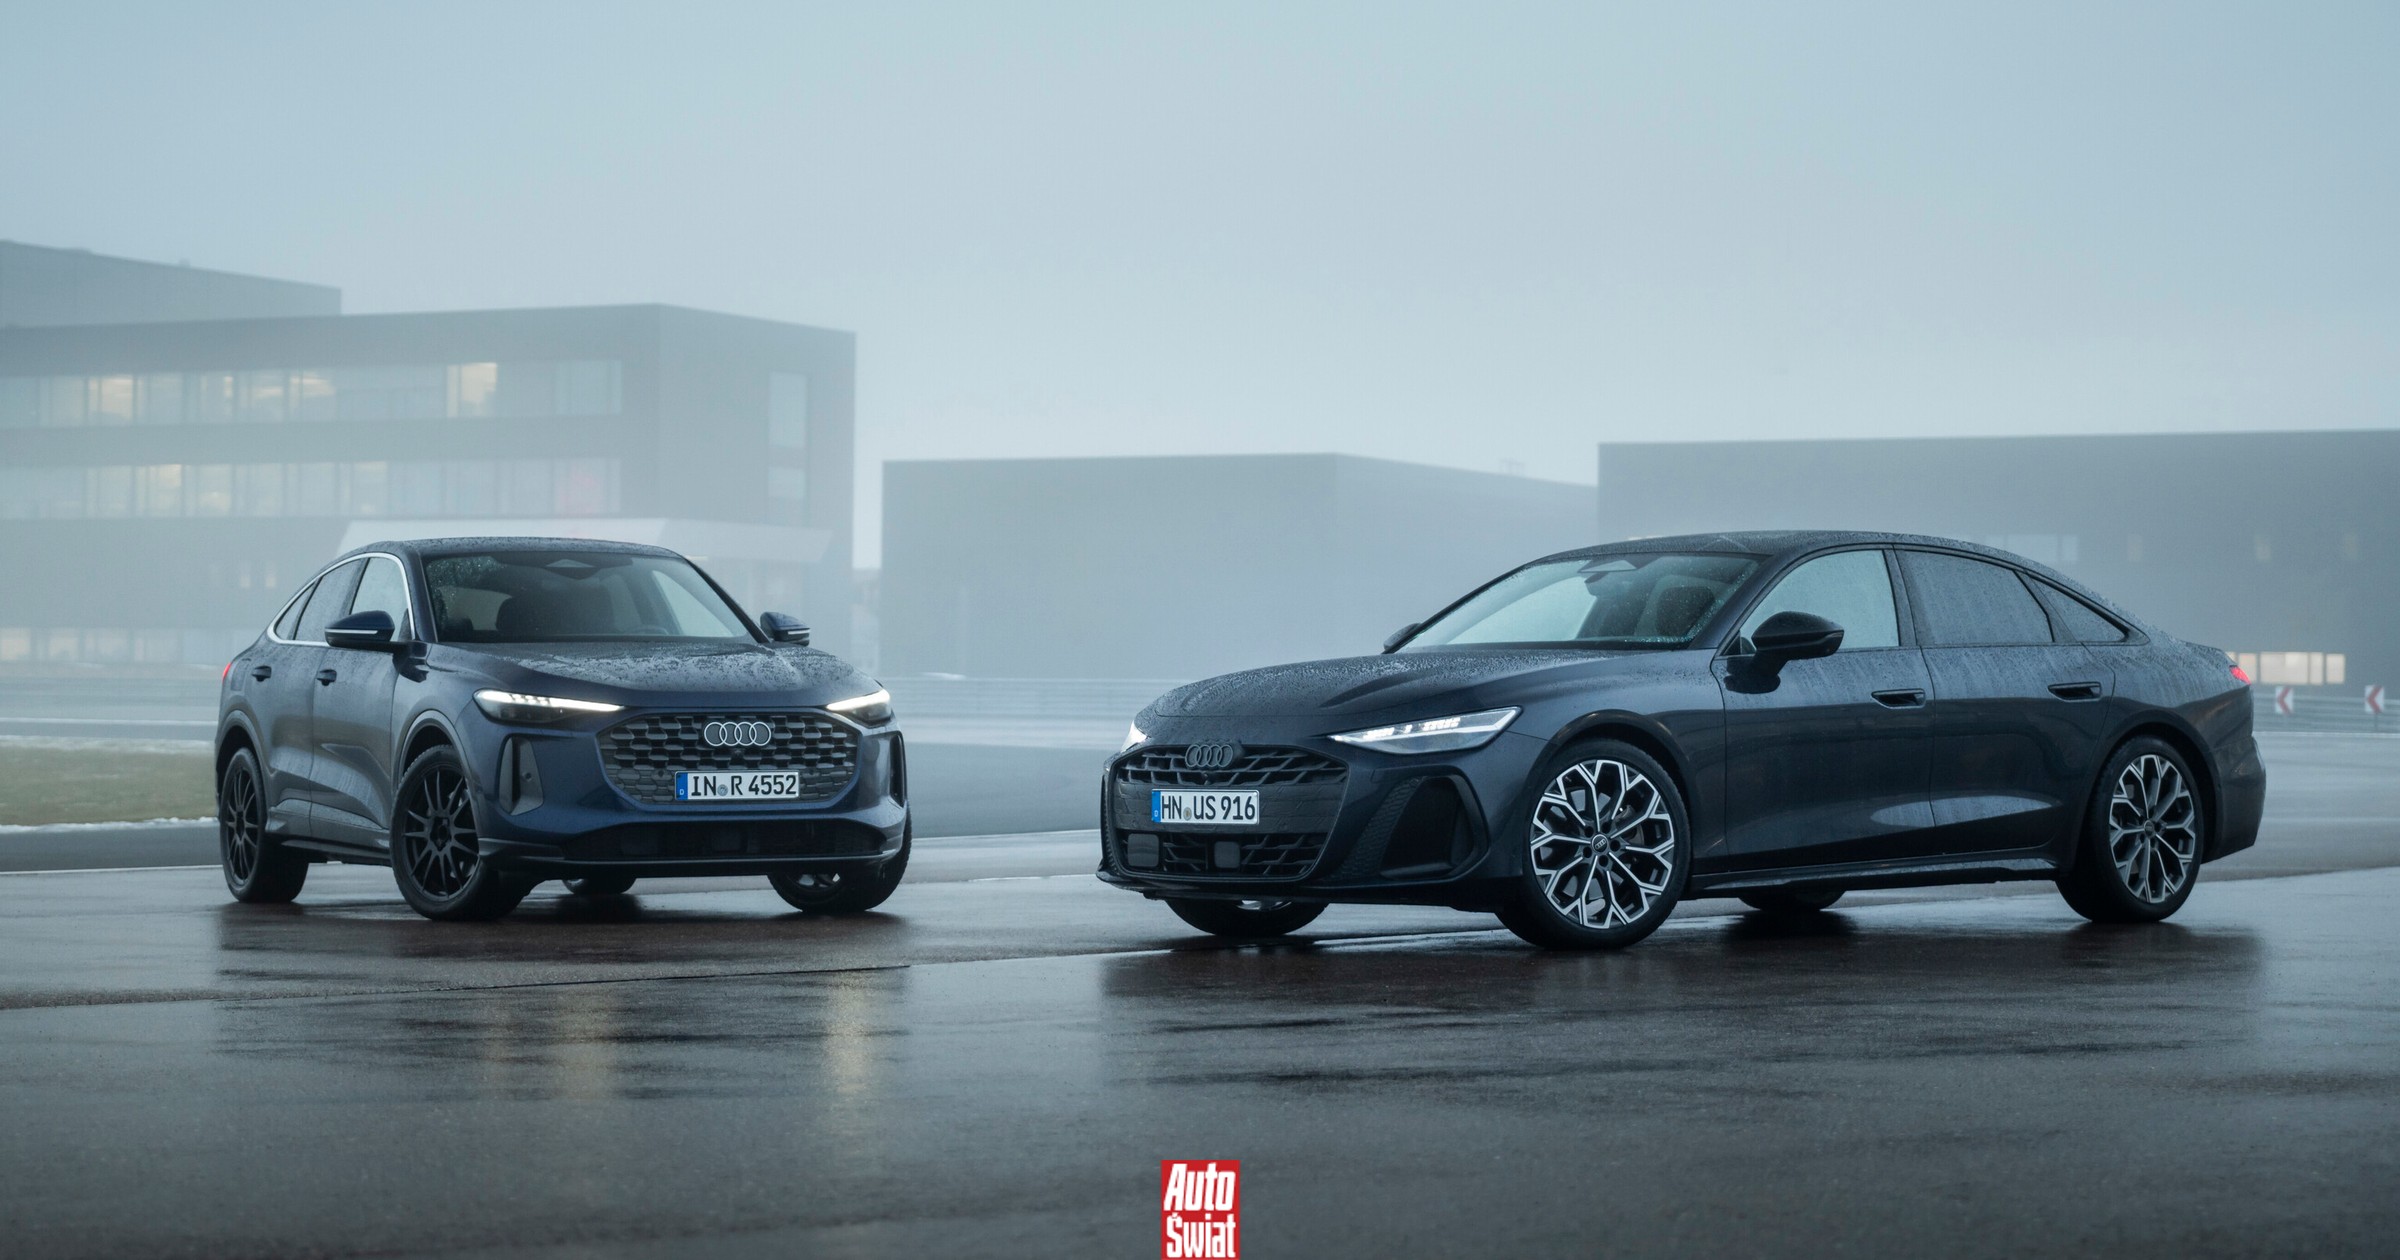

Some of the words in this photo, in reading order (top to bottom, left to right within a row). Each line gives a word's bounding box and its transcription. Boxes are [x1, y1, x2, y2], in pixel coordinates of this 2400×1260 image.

[691, 776, 717, 796] IN
[731, 776, 743, 796] R
[748, 775, 797, 796] 4552
[1162, 796, 1182, 819] HN
[1194, 796, 1216, 820] US
[1221, 796, 1256, 820] 916
